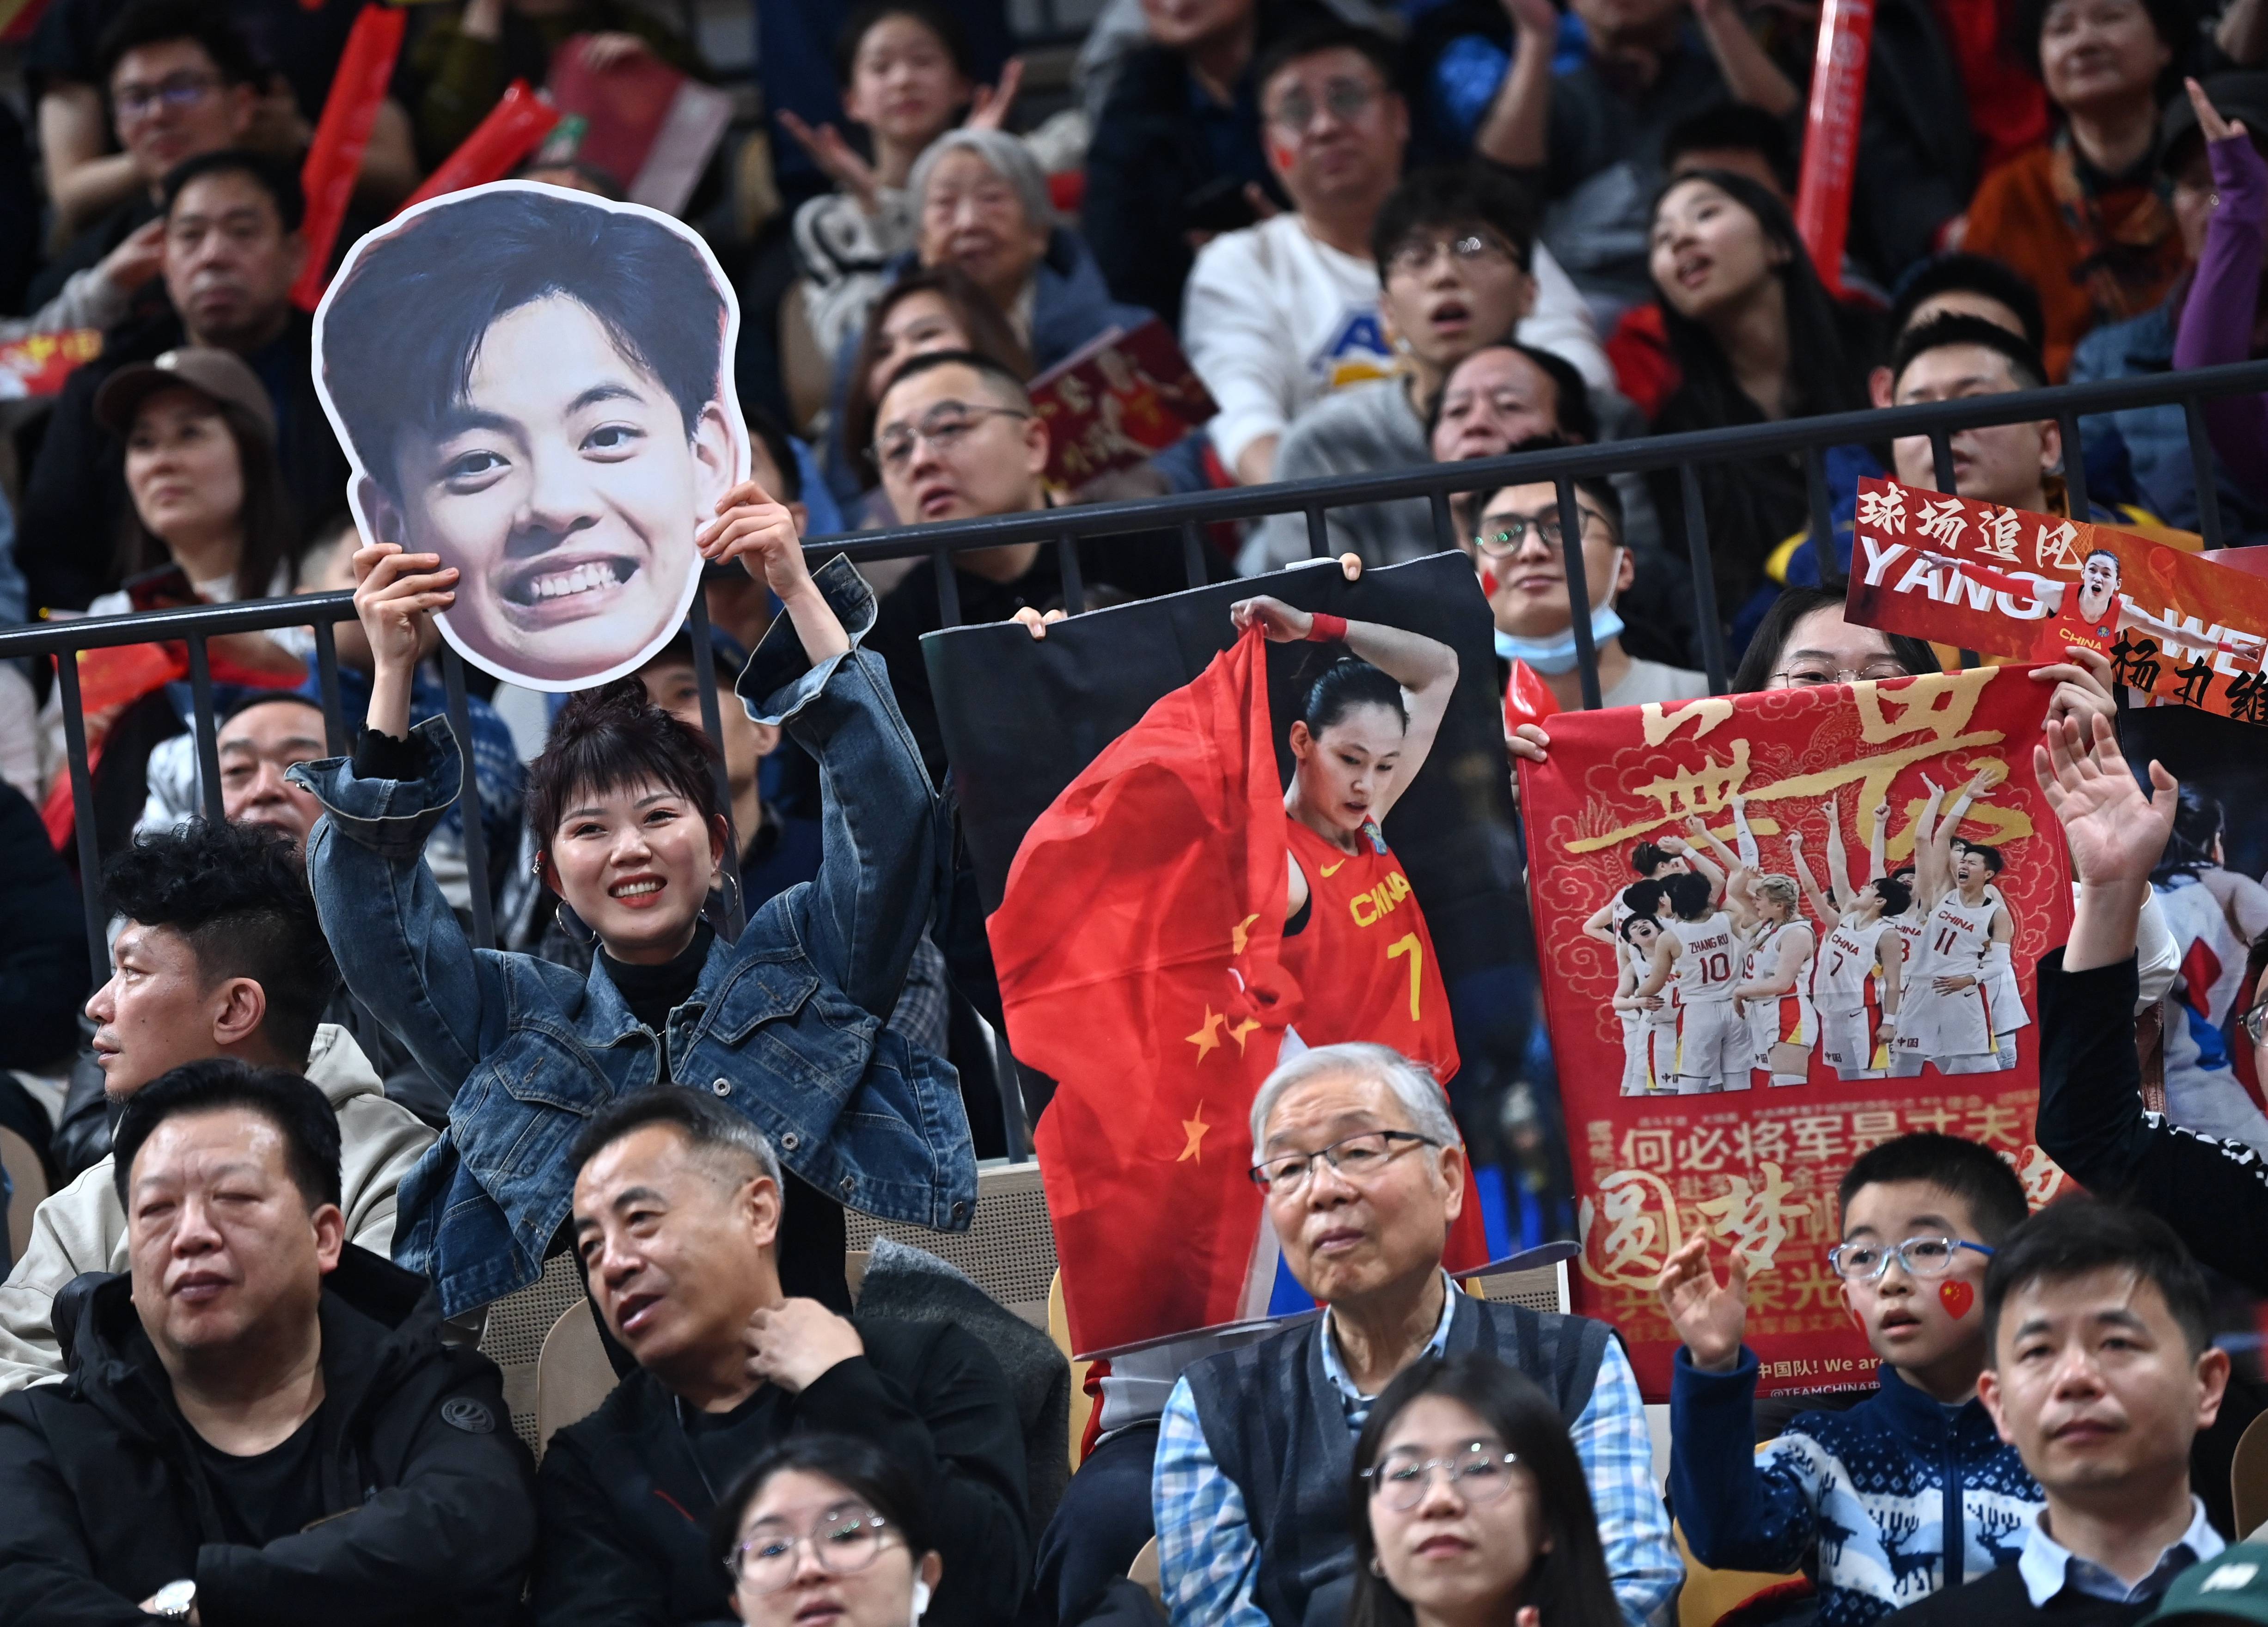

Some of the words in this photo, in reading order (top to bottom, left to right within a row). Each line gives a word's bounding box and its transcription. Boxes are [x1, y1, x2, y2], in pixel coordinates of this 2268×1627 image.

[1858, 482, 2083, 570] 球场追风
[1860, 535, 2048, 620] YANG
[2059, 628, 2102, 650] CHINA
[1895, 924, 1921, 936] HINA
[1938, 910, 1975, 933] CHINA
[1688, 938, 1718, 954] ZHANG
[1717, 933, 1729, 950] RU
[1831, 934, 1860, 955] CHINA
[1933, 927, 1957, 955] 11
[1699, 952, 1730, 984] 10
[1830, 950, 1843, 977] 7
[1387, 931, 1422, 1021] 7
[1897, 1037, 1919, 1048] 中国
[1824, 1358, 1853, 1372] We
